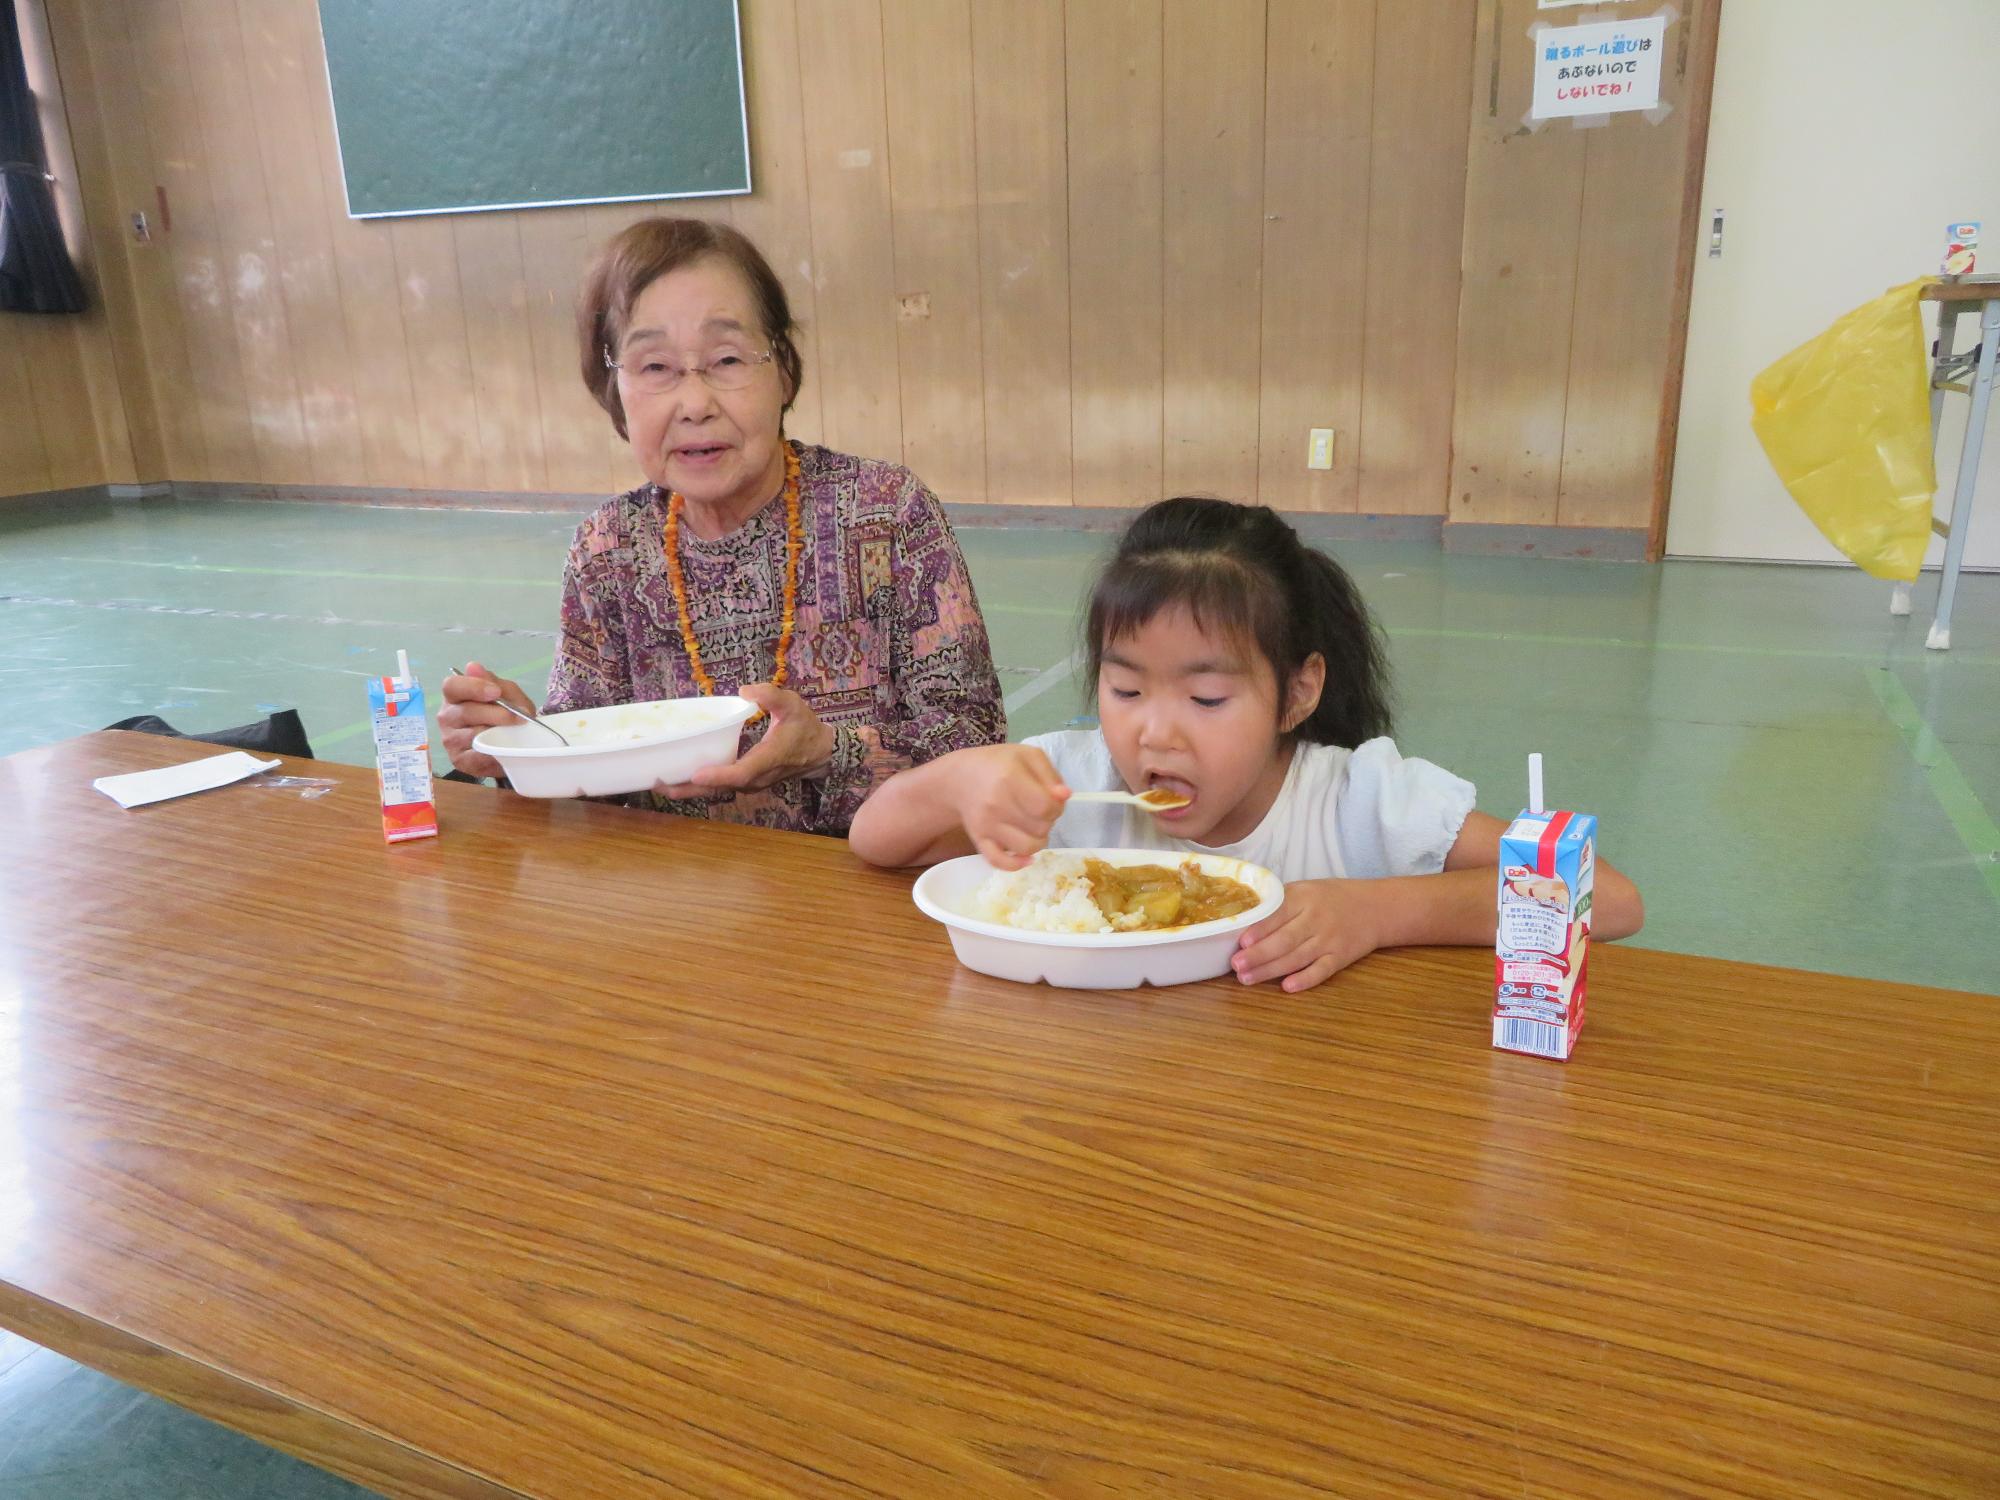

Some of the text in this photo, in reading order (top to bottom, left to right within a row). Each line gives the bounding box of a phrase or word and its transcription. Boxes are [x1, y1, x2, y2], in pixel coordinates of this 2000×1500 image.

[1558, 60, 1637, 80] あぶないので
[1557, 81, 1632, 100] しないでね！
[1508, 868, 1527, 877] Dole
